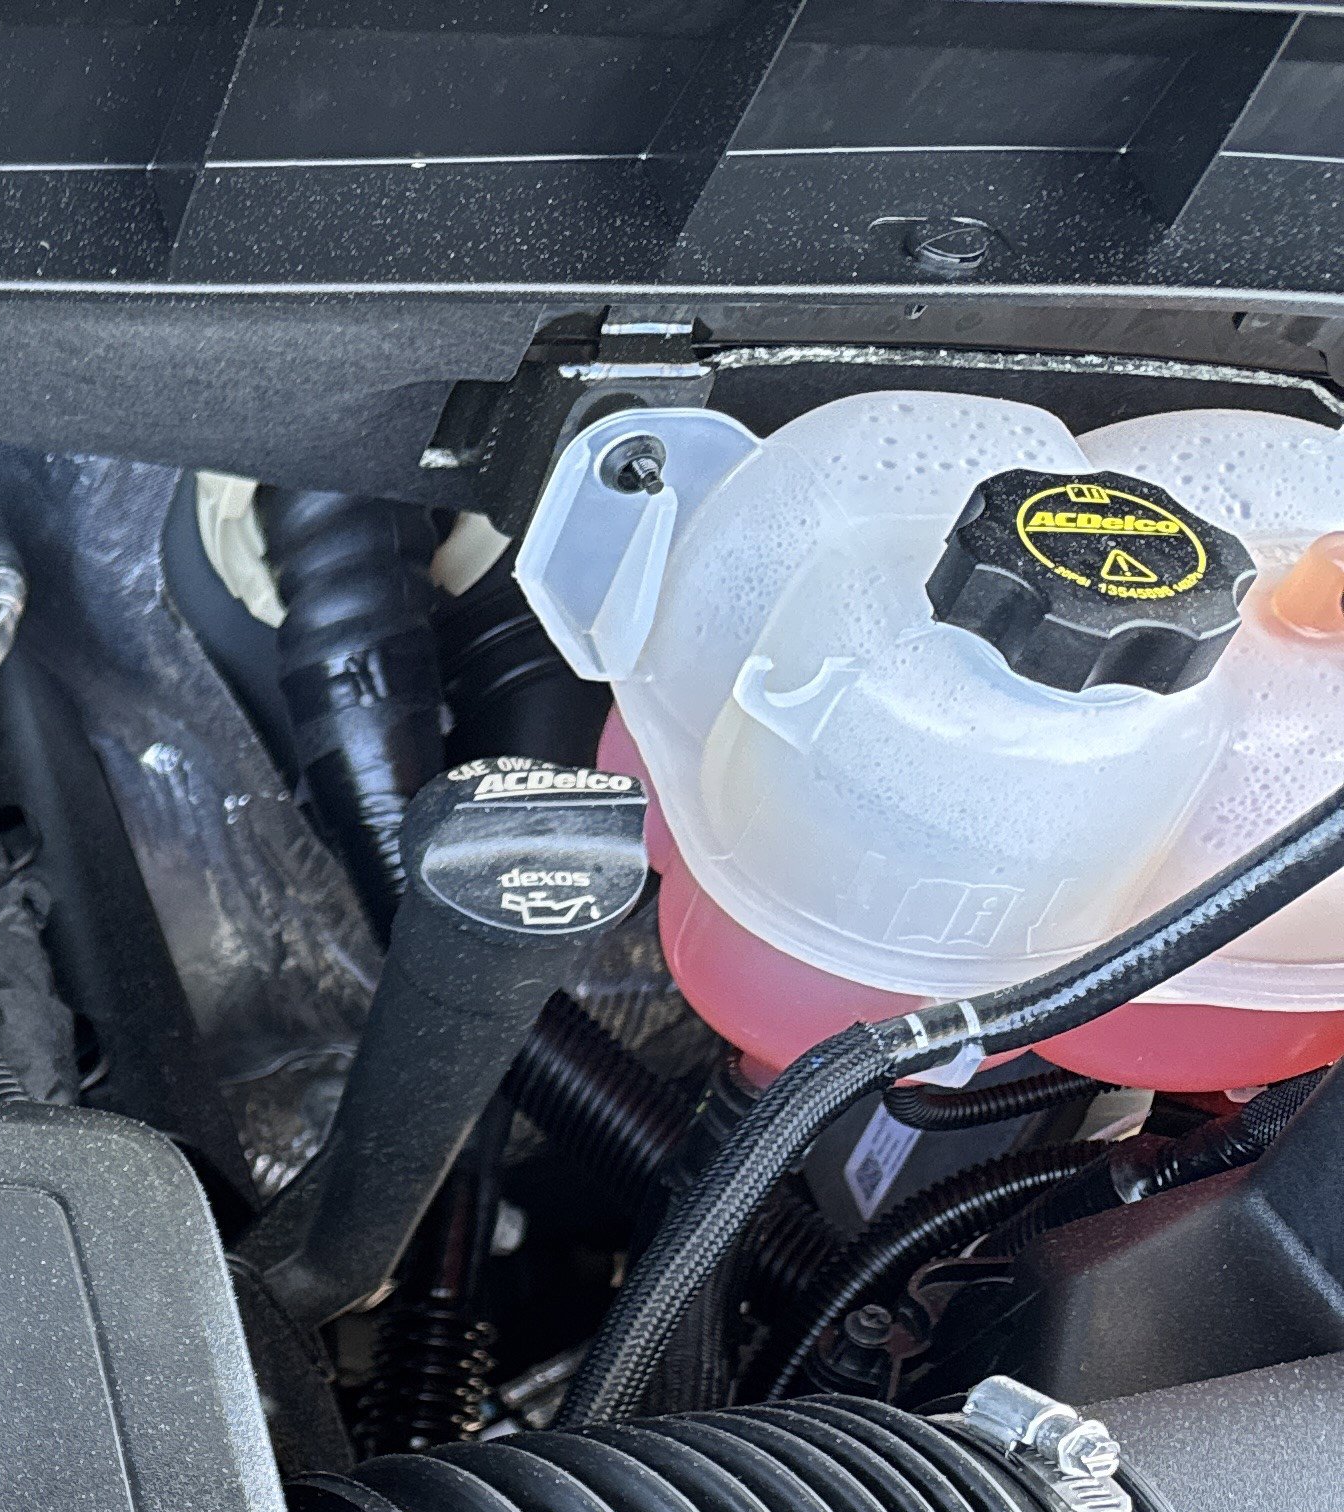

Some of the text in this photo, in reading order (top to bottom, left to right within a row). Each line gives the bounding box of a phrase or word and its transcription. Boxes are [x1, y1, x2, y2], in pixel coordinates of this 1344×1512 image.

[1028, 511, 1180, 534] ACDelco
[447, 760, 490, 781] SAE
[474, 768, 632, 795] ACDelco
[501, 868, 590, 888] dexos
